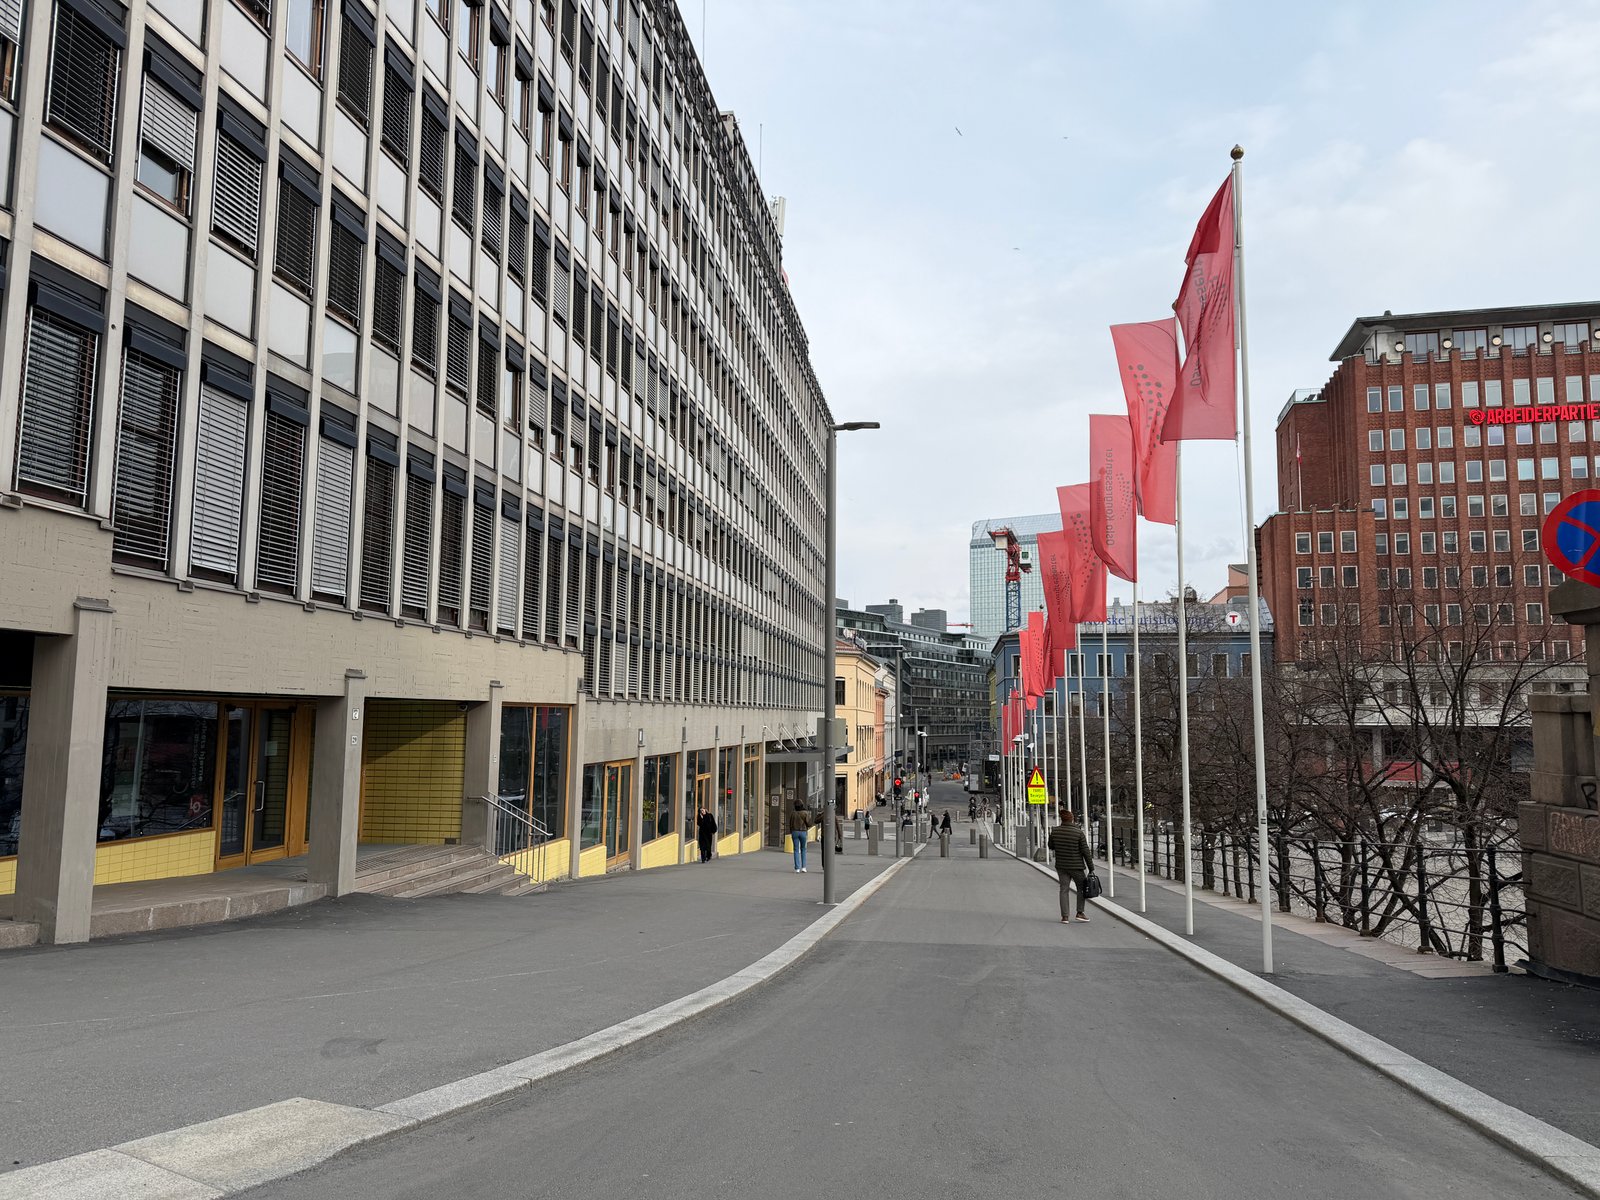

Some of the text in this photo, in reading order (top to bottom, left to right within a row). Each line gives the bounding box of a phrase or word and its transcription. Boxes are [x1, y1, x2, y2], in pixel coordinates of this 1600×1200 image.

[1486, 403, 1600, 424] ARBEIDERPARTIE
[1130, 614, 1215, 629] Turistfoning
[1229, 615, 1238, 624] T
